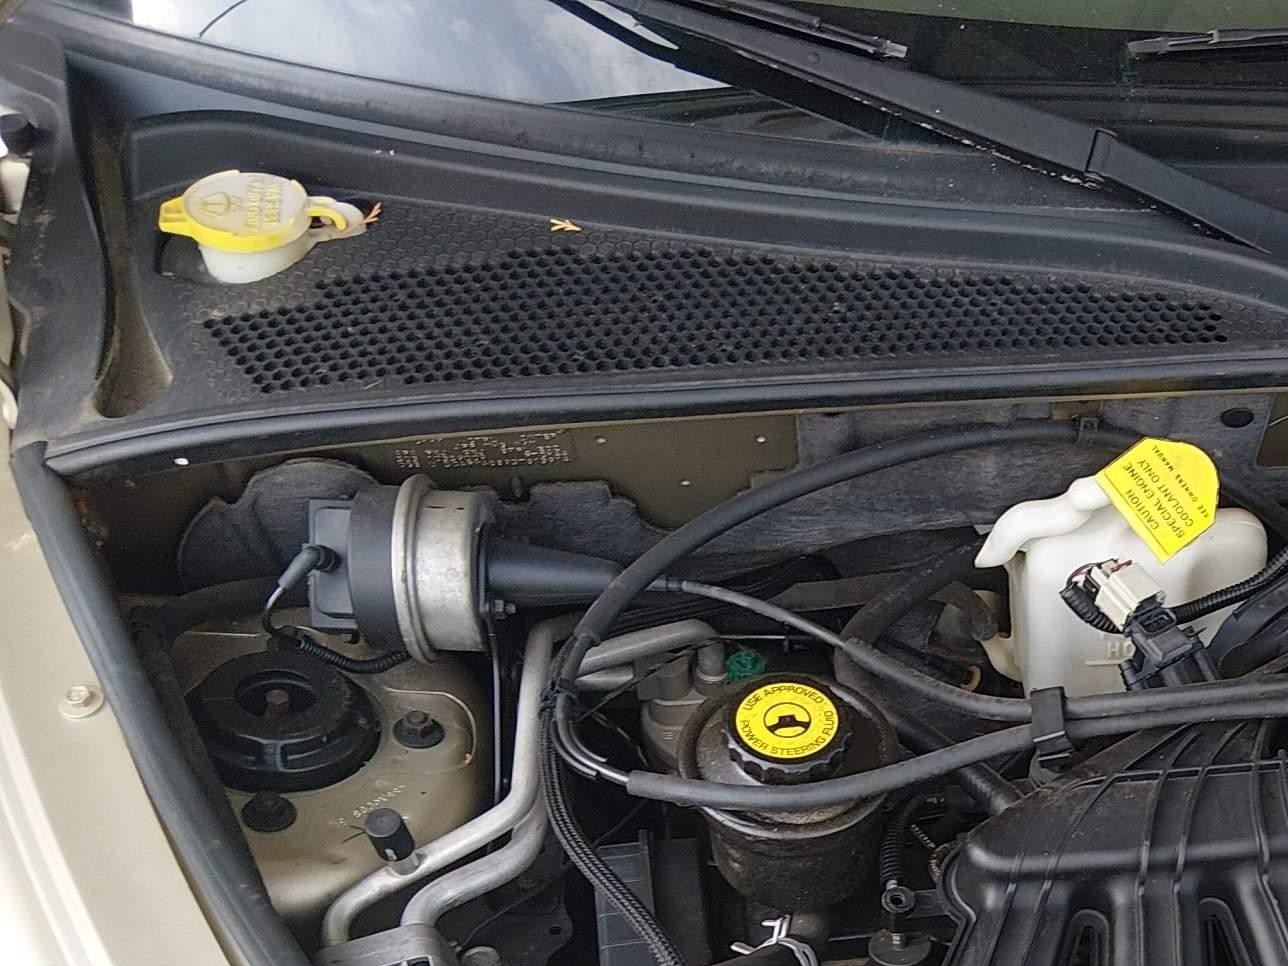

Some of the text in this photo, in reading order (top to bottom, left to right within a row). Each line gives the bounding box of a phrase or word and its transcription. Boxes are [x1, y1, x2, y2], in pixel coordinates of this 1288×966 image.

[1122, 462, 1185, 538] SPECIAL ENGINE
[1125, 488, 1160, 530] CAUTION
[1137, 459, 1194, 527] COOLANT ONLY
[1152, 445, 1209, 518] SEE OWNERS MANUAL
[743, 685, 825, 711] USE APPROVED
[740, 710, 835, 756] POWER STEERING FLUID
